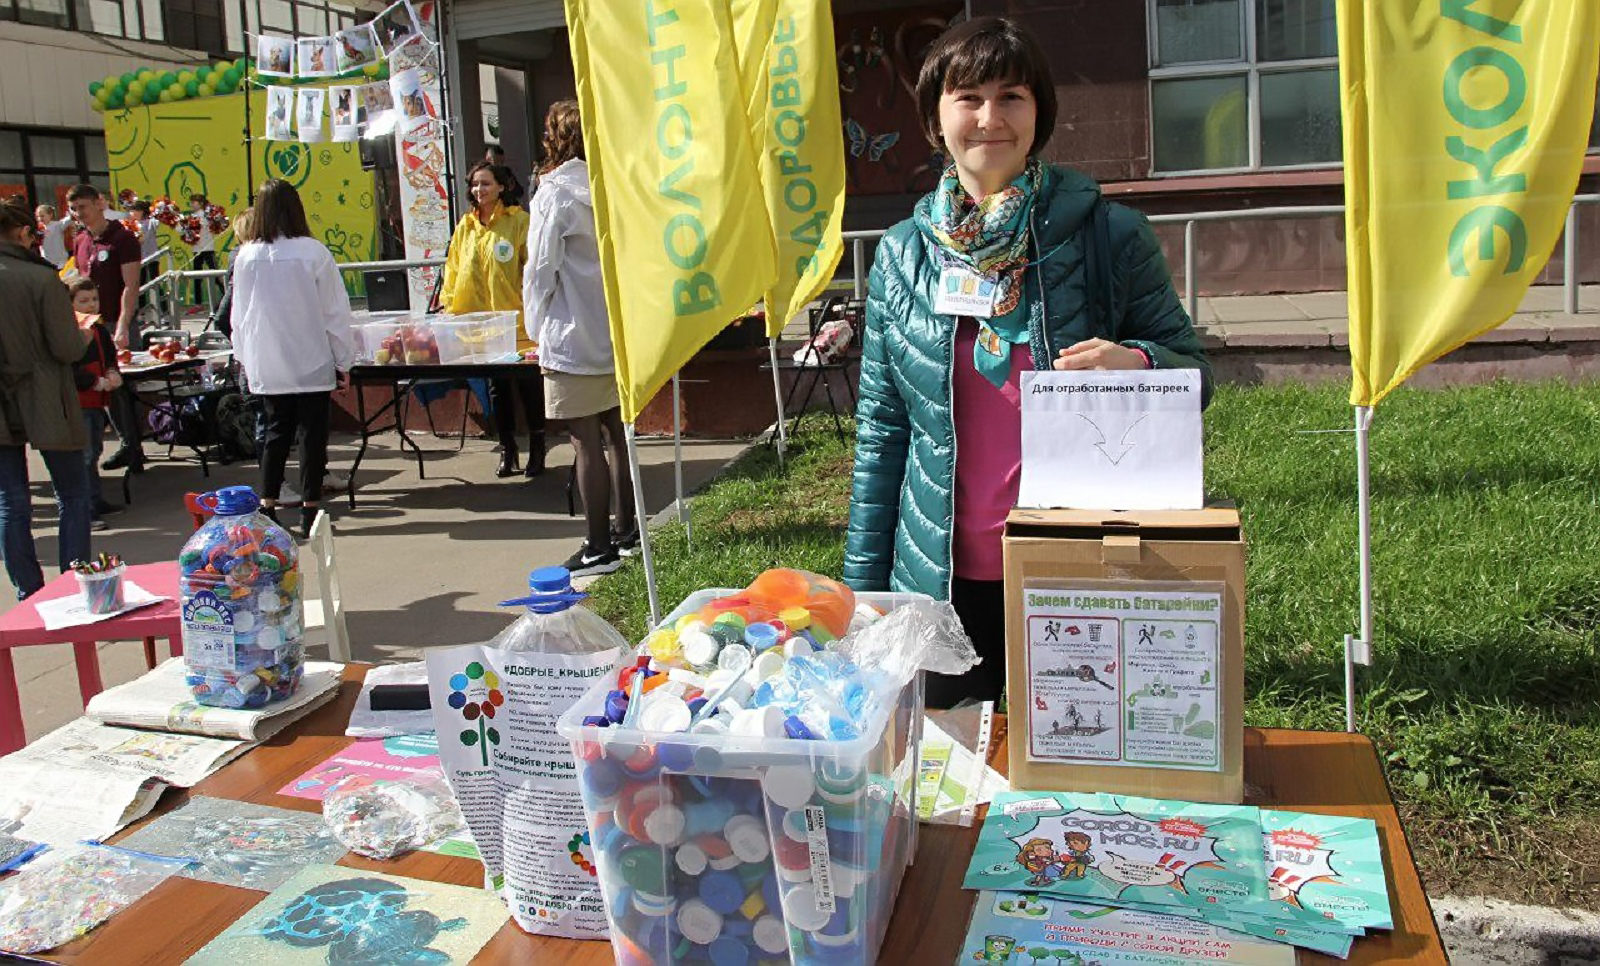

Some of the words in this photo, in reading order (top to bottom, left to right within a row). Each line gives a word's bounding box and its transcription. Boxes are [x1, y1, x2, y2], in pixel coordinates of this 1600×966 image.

[771, 15, 830, 277] ЗДОРОВЬЕ
[1032, 383, 1054, 395] Для
[1056, 383, 1135, 396] отработанных
[1138, 382, 1190, 395] батареек
[1028, 593, 1072, 608] Зачем
[1075, 595, 1131, 610] сдавать
[1134, 595, 1219, 612] батарейки?
[493, 748, 541, 767] Собирайте
[543, 760, 576, 771] крыш
[1100, 831, 1201, 851] MOS.RU
[993, 864, 1009, 872] 6+
[545, 899, 572, 911] ДОБРО
[580, 904, 605, 913] ПРОС
[1044, 924, 1085, 934] ПРИМИ
[1090, 928, 1143, 939] УЧАСТИЕ
[1159, 935, 1200, 946] АКЦИИ
[1205, 939, 1232, 948] САМ
[1060, 934, 1117, 947] ПРИВЕДИ
